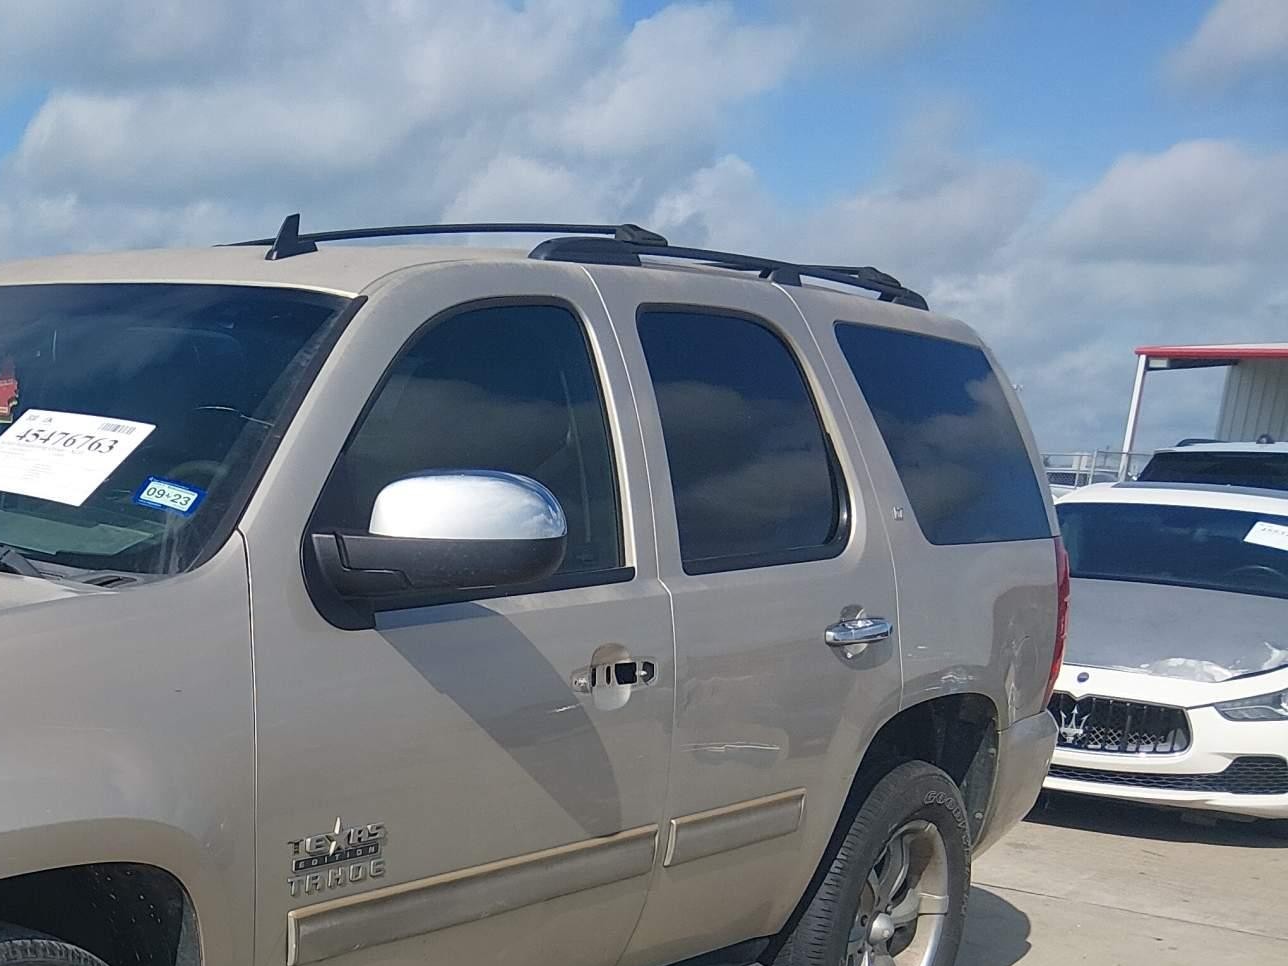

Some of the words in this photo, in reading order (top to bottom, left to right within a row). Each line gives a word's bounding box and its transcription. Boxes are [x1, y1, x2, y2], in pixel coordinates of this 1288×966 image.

[16, 427, 119, 454] 45476763
[287, 816, 385, 857] TEXAS
[298, 845, 376, 868] EDITION
[287, 859, 386, 897] TAHOE
